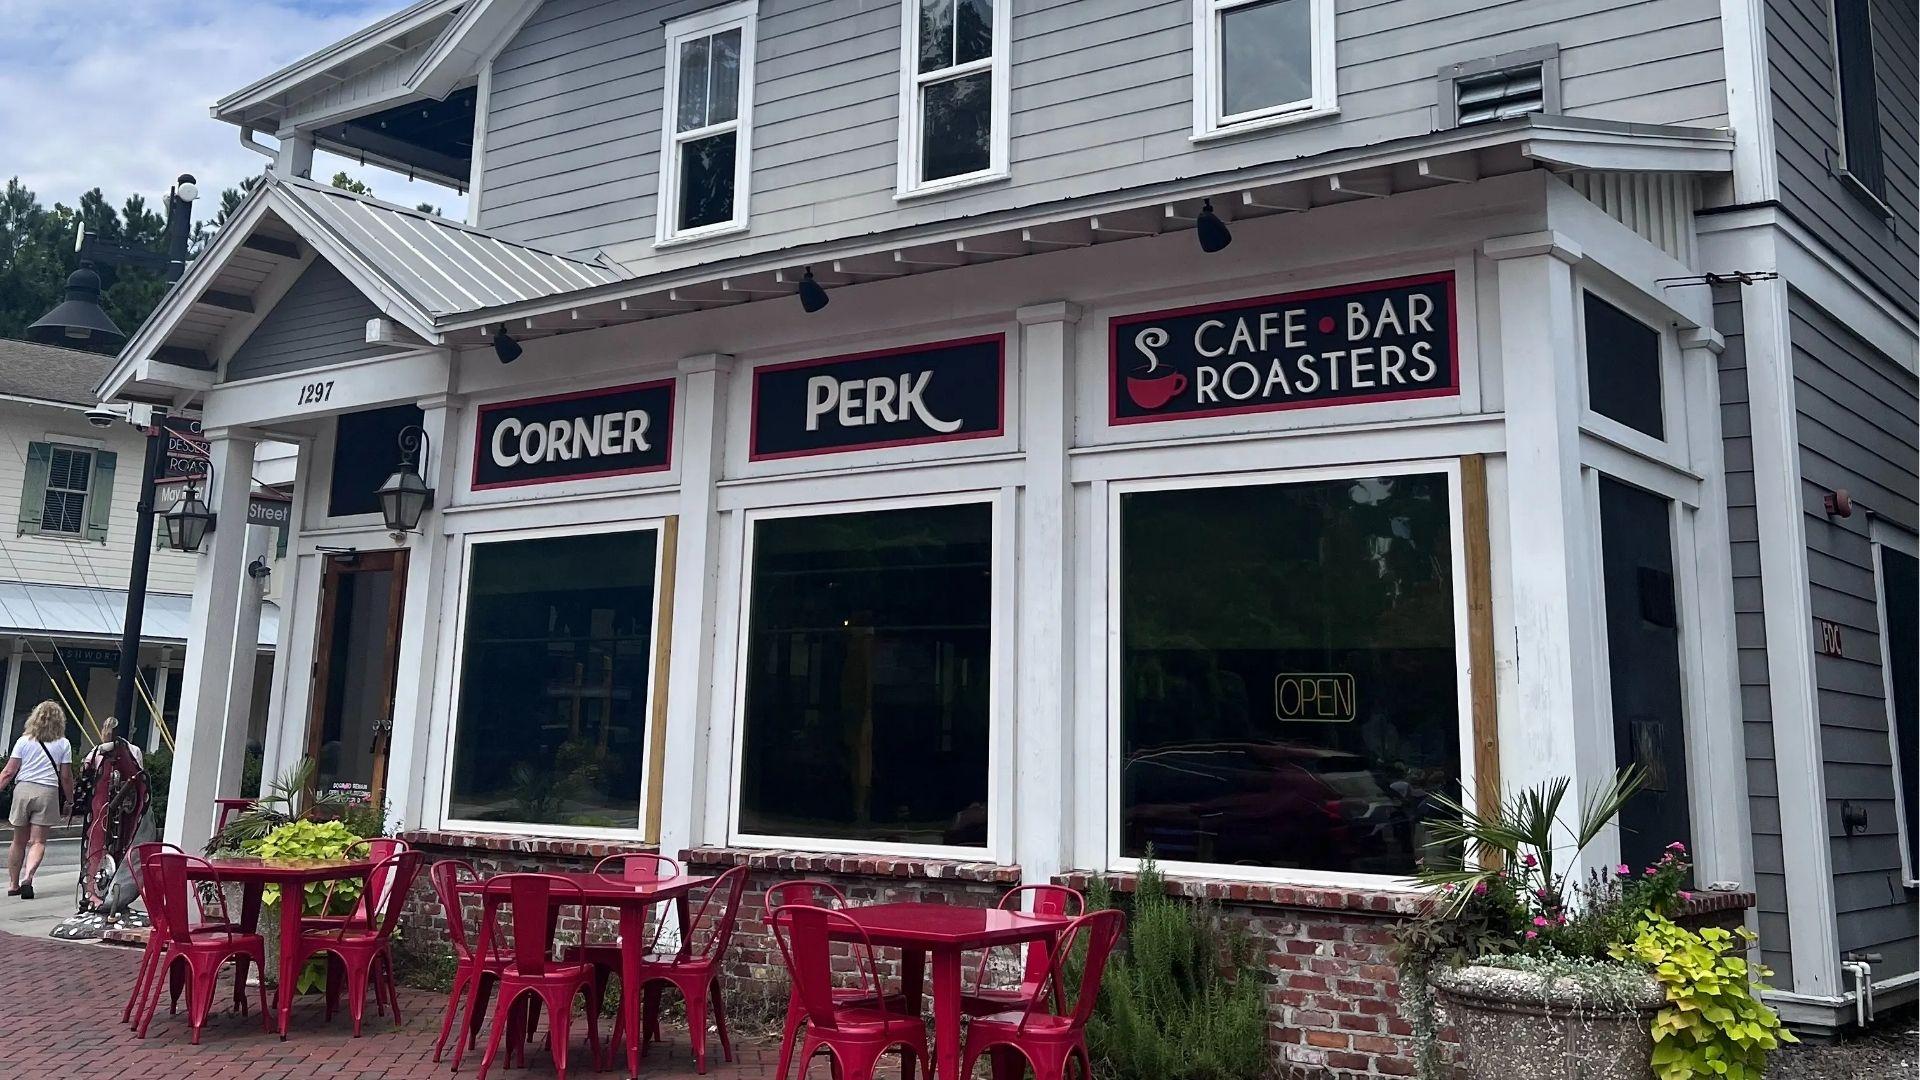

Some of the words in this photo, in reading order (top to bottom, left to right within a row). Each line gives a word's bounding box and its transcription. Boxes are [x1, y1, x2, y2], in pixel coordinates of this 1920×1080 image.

[1193, 308, 1308, 358] CAFE
[1346, 293, 1435, 343] BAR
[1196, 341, 1438, 404] ROASTERS
[297, 380, 335, 406] 1297
[805, 370, 963, 433] PERK
[190, 421, 203, 434] C
[491, 408, 652, 468] CORNER
[169, 457, 207, 472] ROAS
[161, 486, 181, 502] May
[249, 503, 288, 521] Street
[1821, 621, 1842, 655] FDC
[1280, 678, 1351, 716] OPEN
